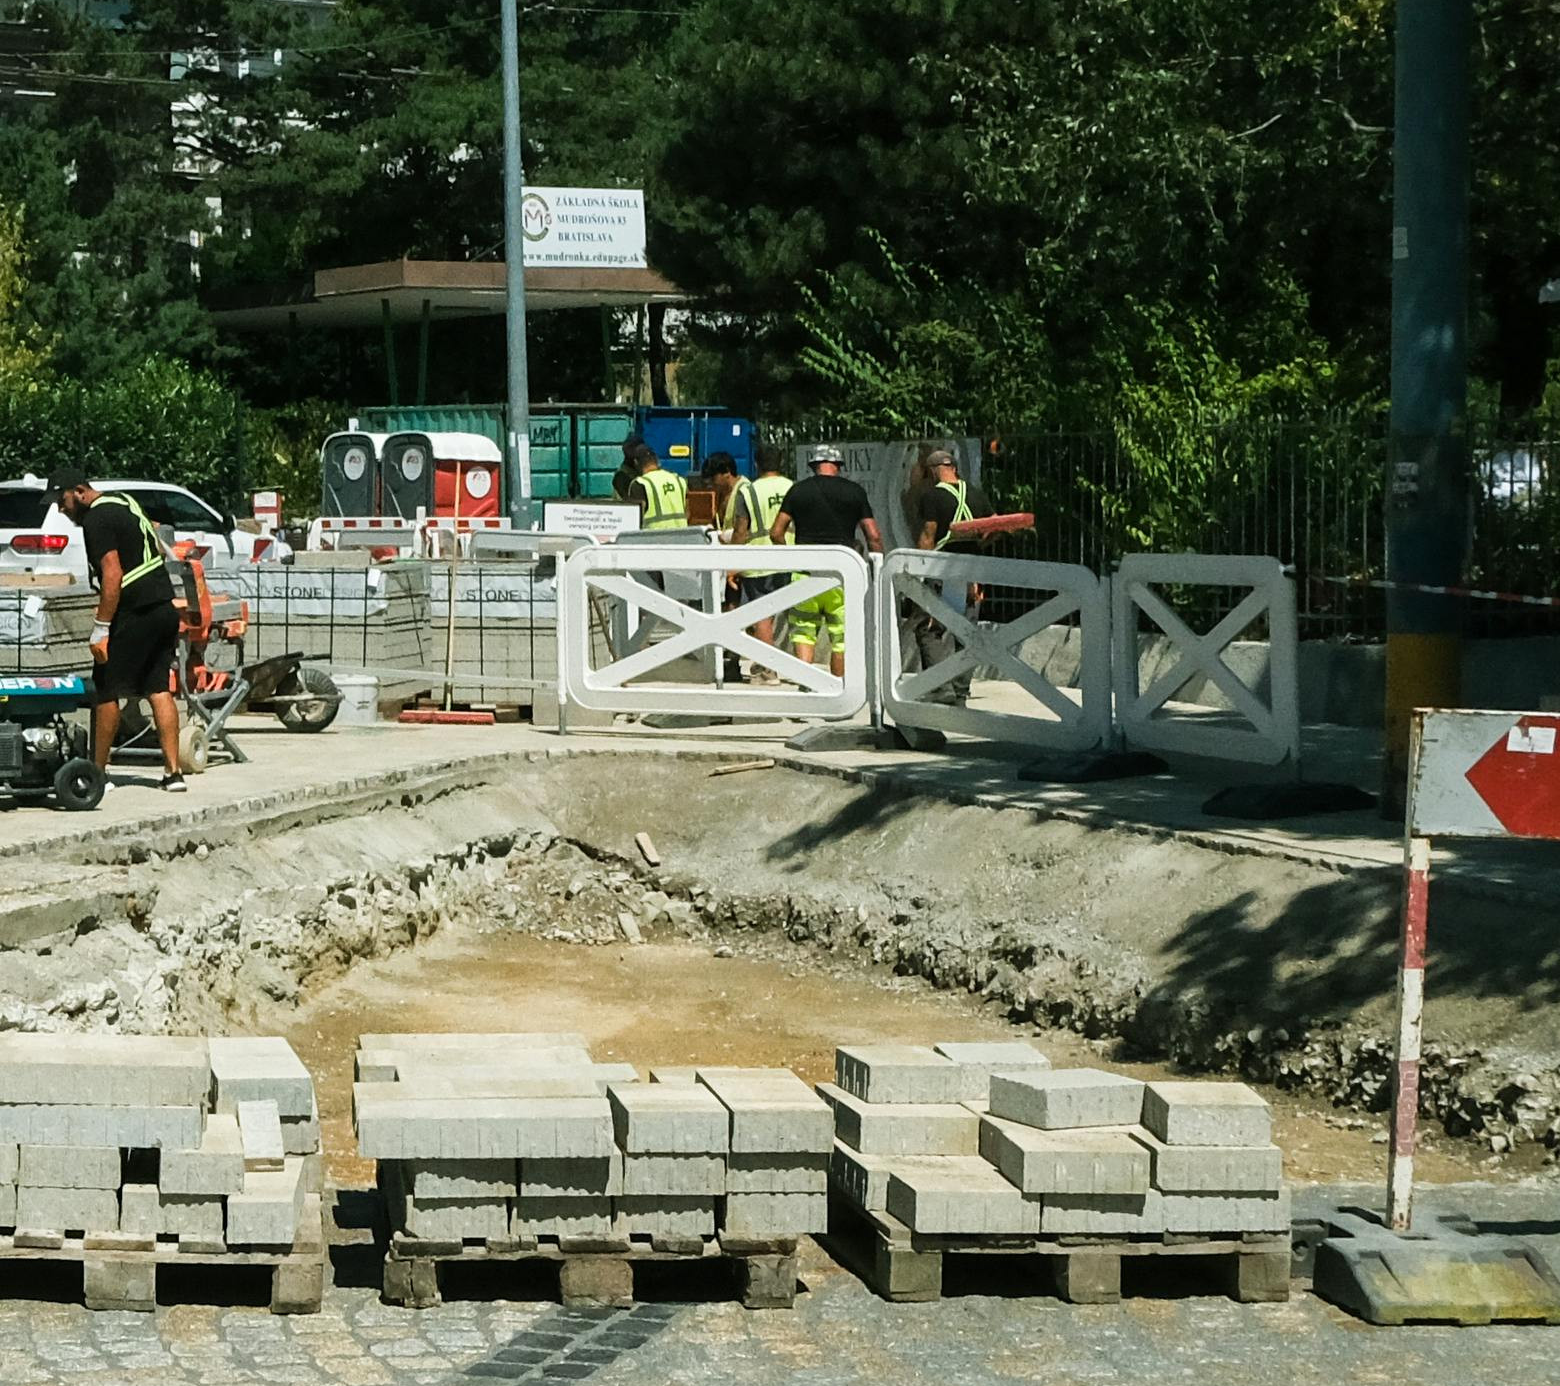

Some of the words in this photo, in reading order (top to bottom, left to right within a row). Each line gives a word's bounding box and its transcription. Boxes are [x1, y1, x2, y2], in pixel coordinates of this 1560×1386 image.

[555, 196, 606, 208] ZÁKLADNÁ
[607, 197, 639, 209] ŠKOLA
[557, 232, 614, 243] BRATISLAVA
